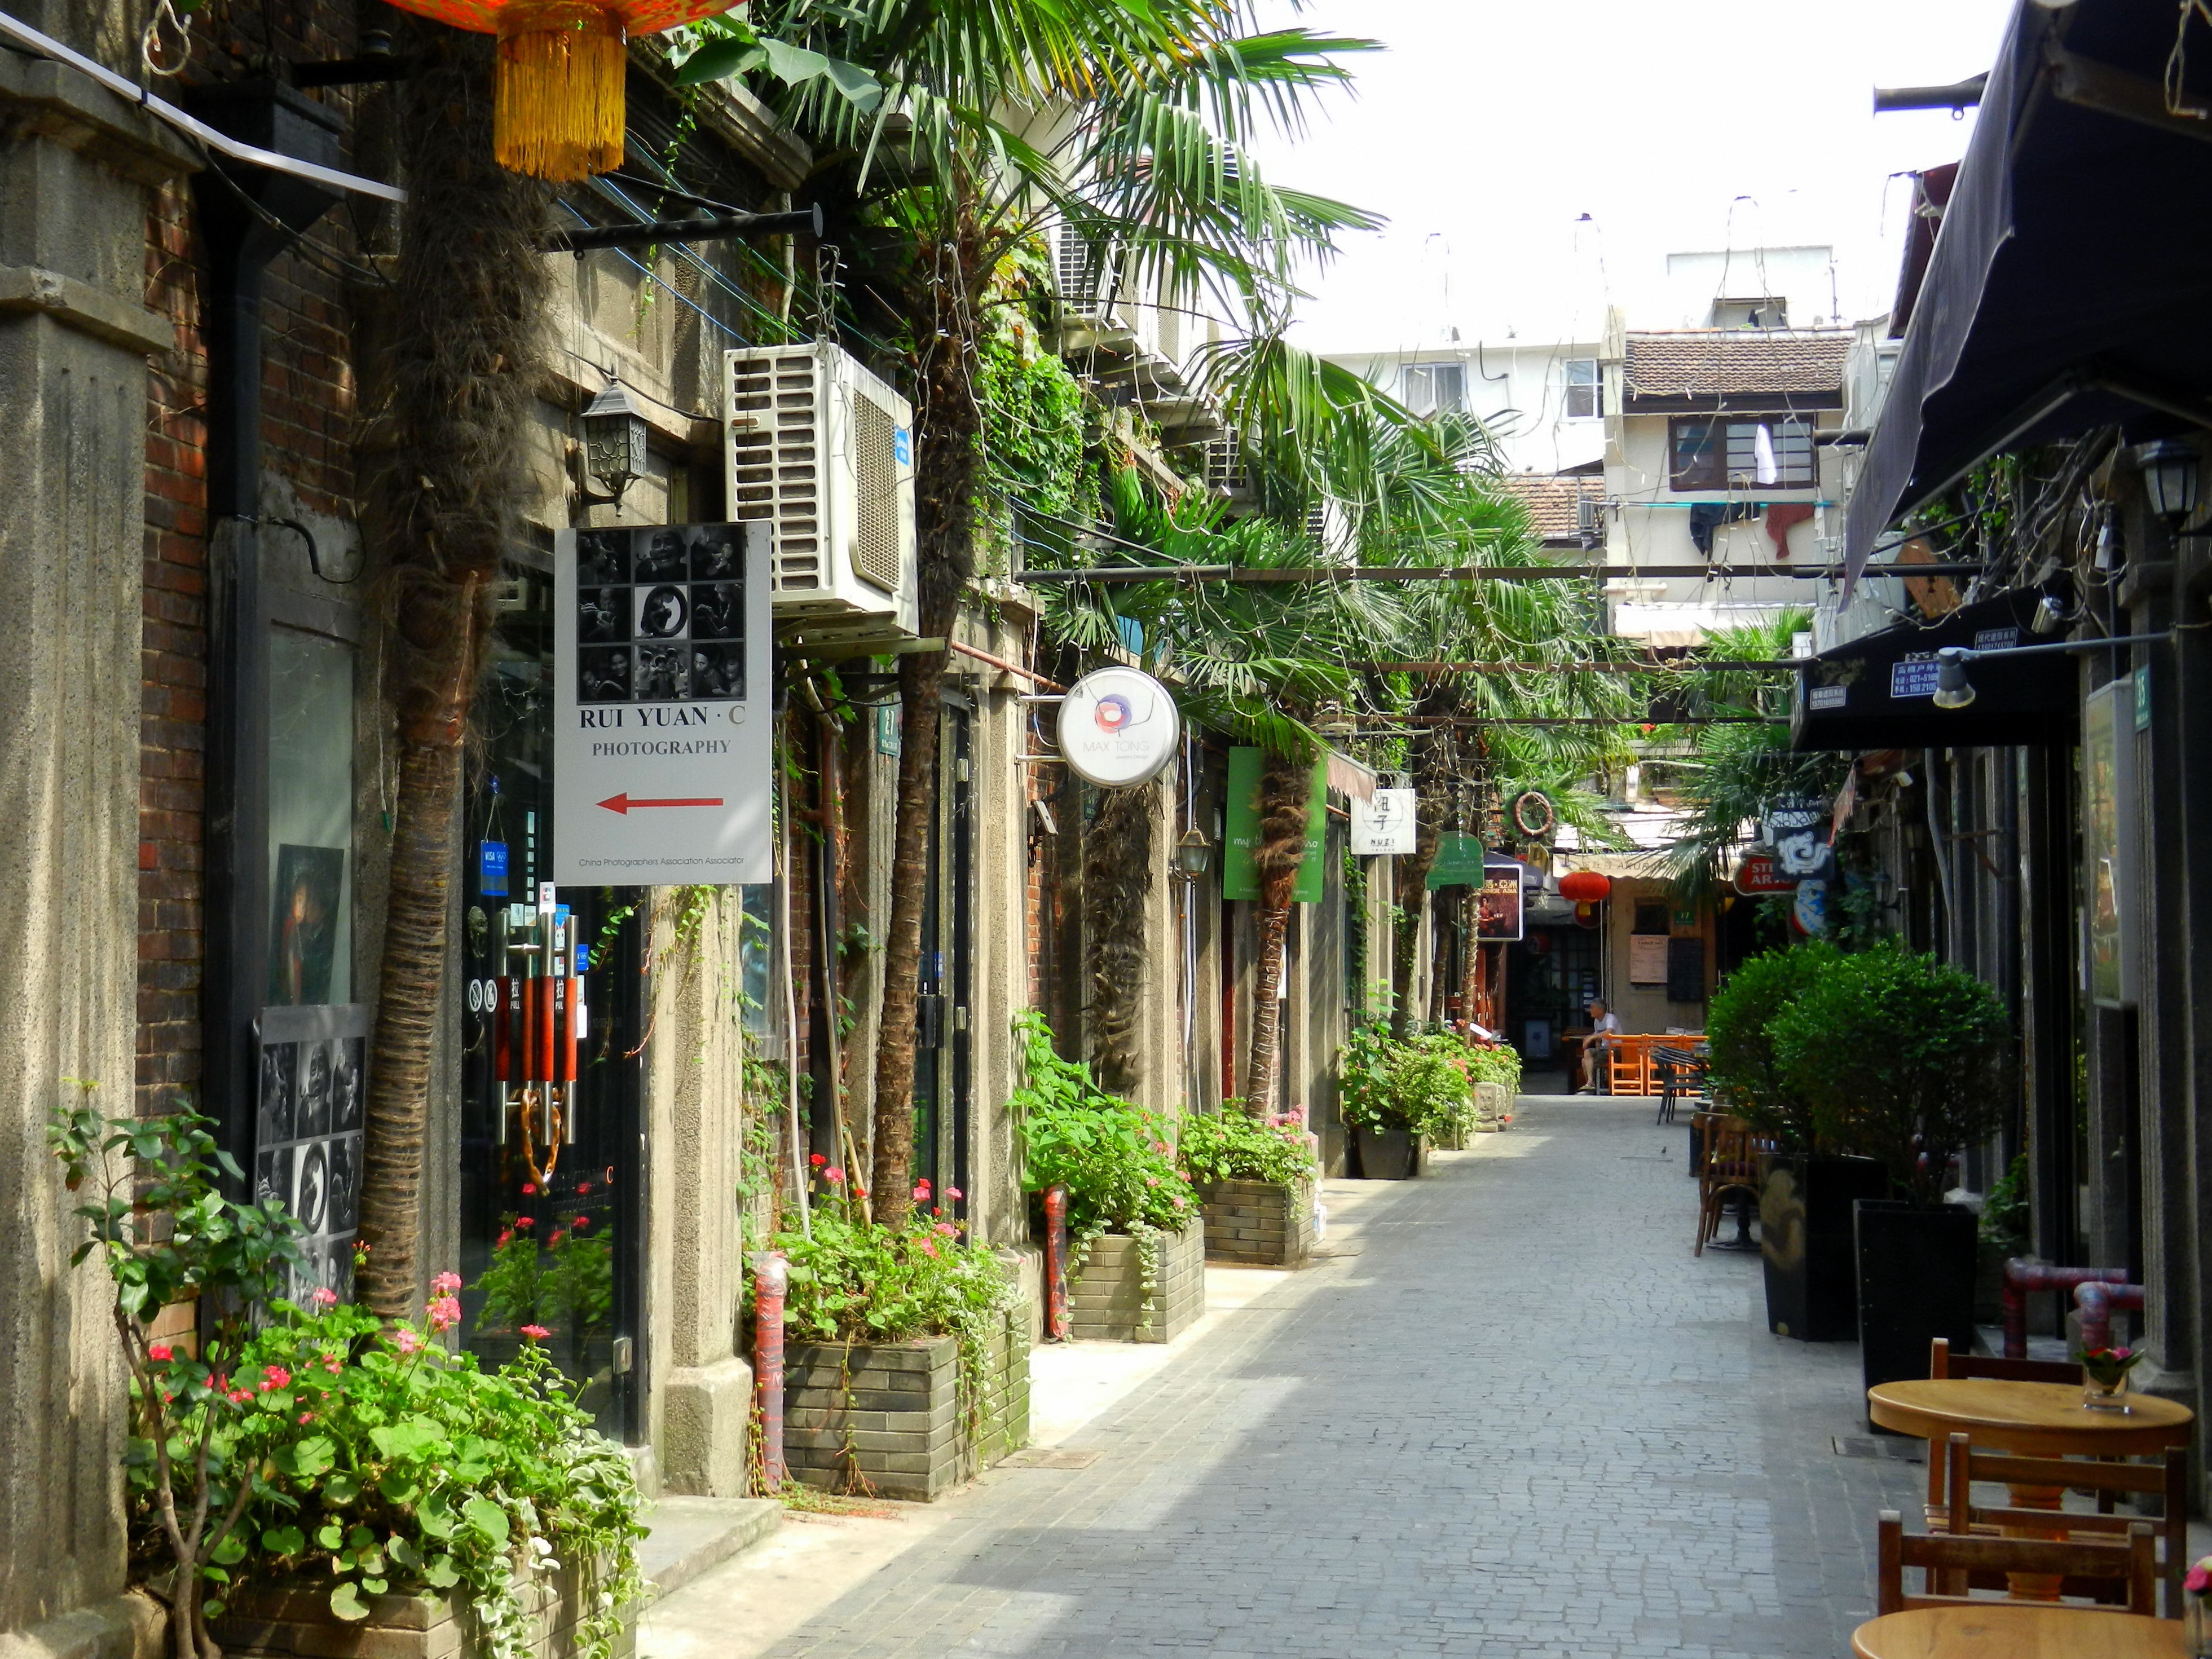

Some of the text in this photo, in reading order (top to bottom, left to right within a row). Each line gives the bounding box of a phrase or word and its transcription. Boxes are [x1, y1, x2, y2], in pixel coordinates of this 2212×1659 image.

[579, 709, 624, 728] RUI
[729, 705, 746, 724] C
[885, 709, 895, 735] 21
[593, 740, 731, 756] PHOTOGRAPHY
[1083, 740, 1149, 752] MAX TONG
[485, 851, 496, 861] VISA
[603, 858, 658, 867] Photographers
[512, 978, 519, 998] 拉
[555, 1001, 563, 1009] PUL
